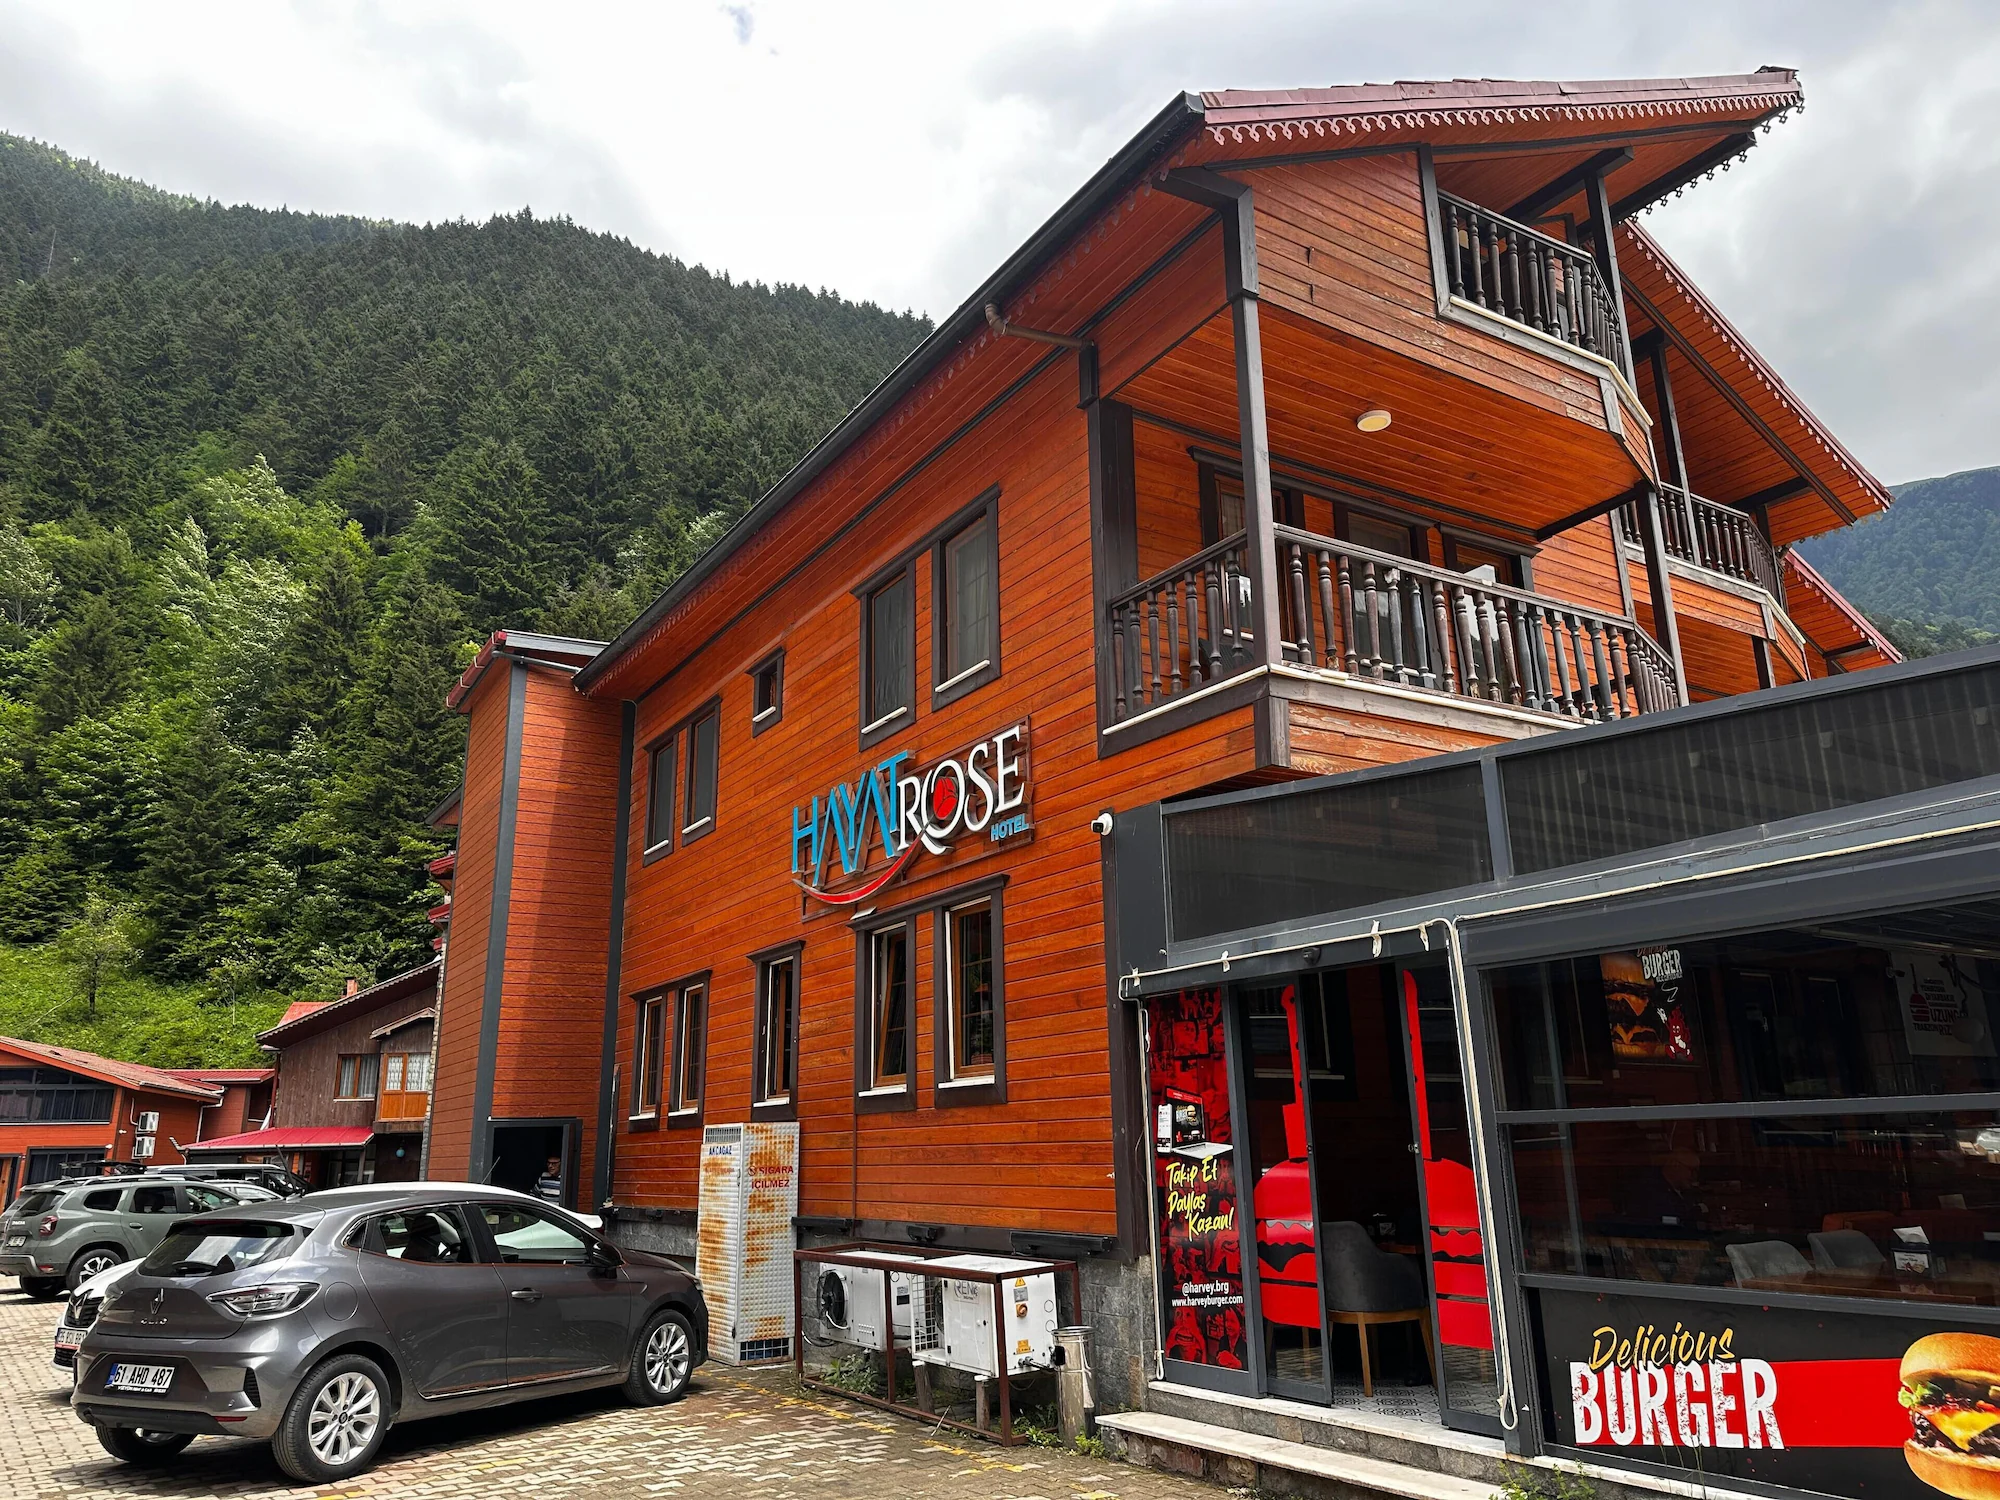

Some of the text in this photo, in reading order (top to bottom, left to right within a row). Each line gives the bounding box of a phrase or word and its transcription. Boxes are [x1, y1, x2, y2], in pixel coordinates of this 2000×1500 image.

[990, 812, 1030, 843] HOTEL
[1641, 949, 1683, 980] BURGER
[1166, 1155, 1218, 1191] Takip Et
[1168, 1190, 1206, 1220] Paylaş
[1171, 1295, 1244, 1308] www.harveyburger.com
[1182, 1280, 1230, 1297] @harvey.brg
[1588, 1321, 1736, 1371] Delicious
[114, 1366, 127, 1383] 61
[151, 1368, 173, 1387] 487
[1569, 1358, 1785, 1450] BURGER
